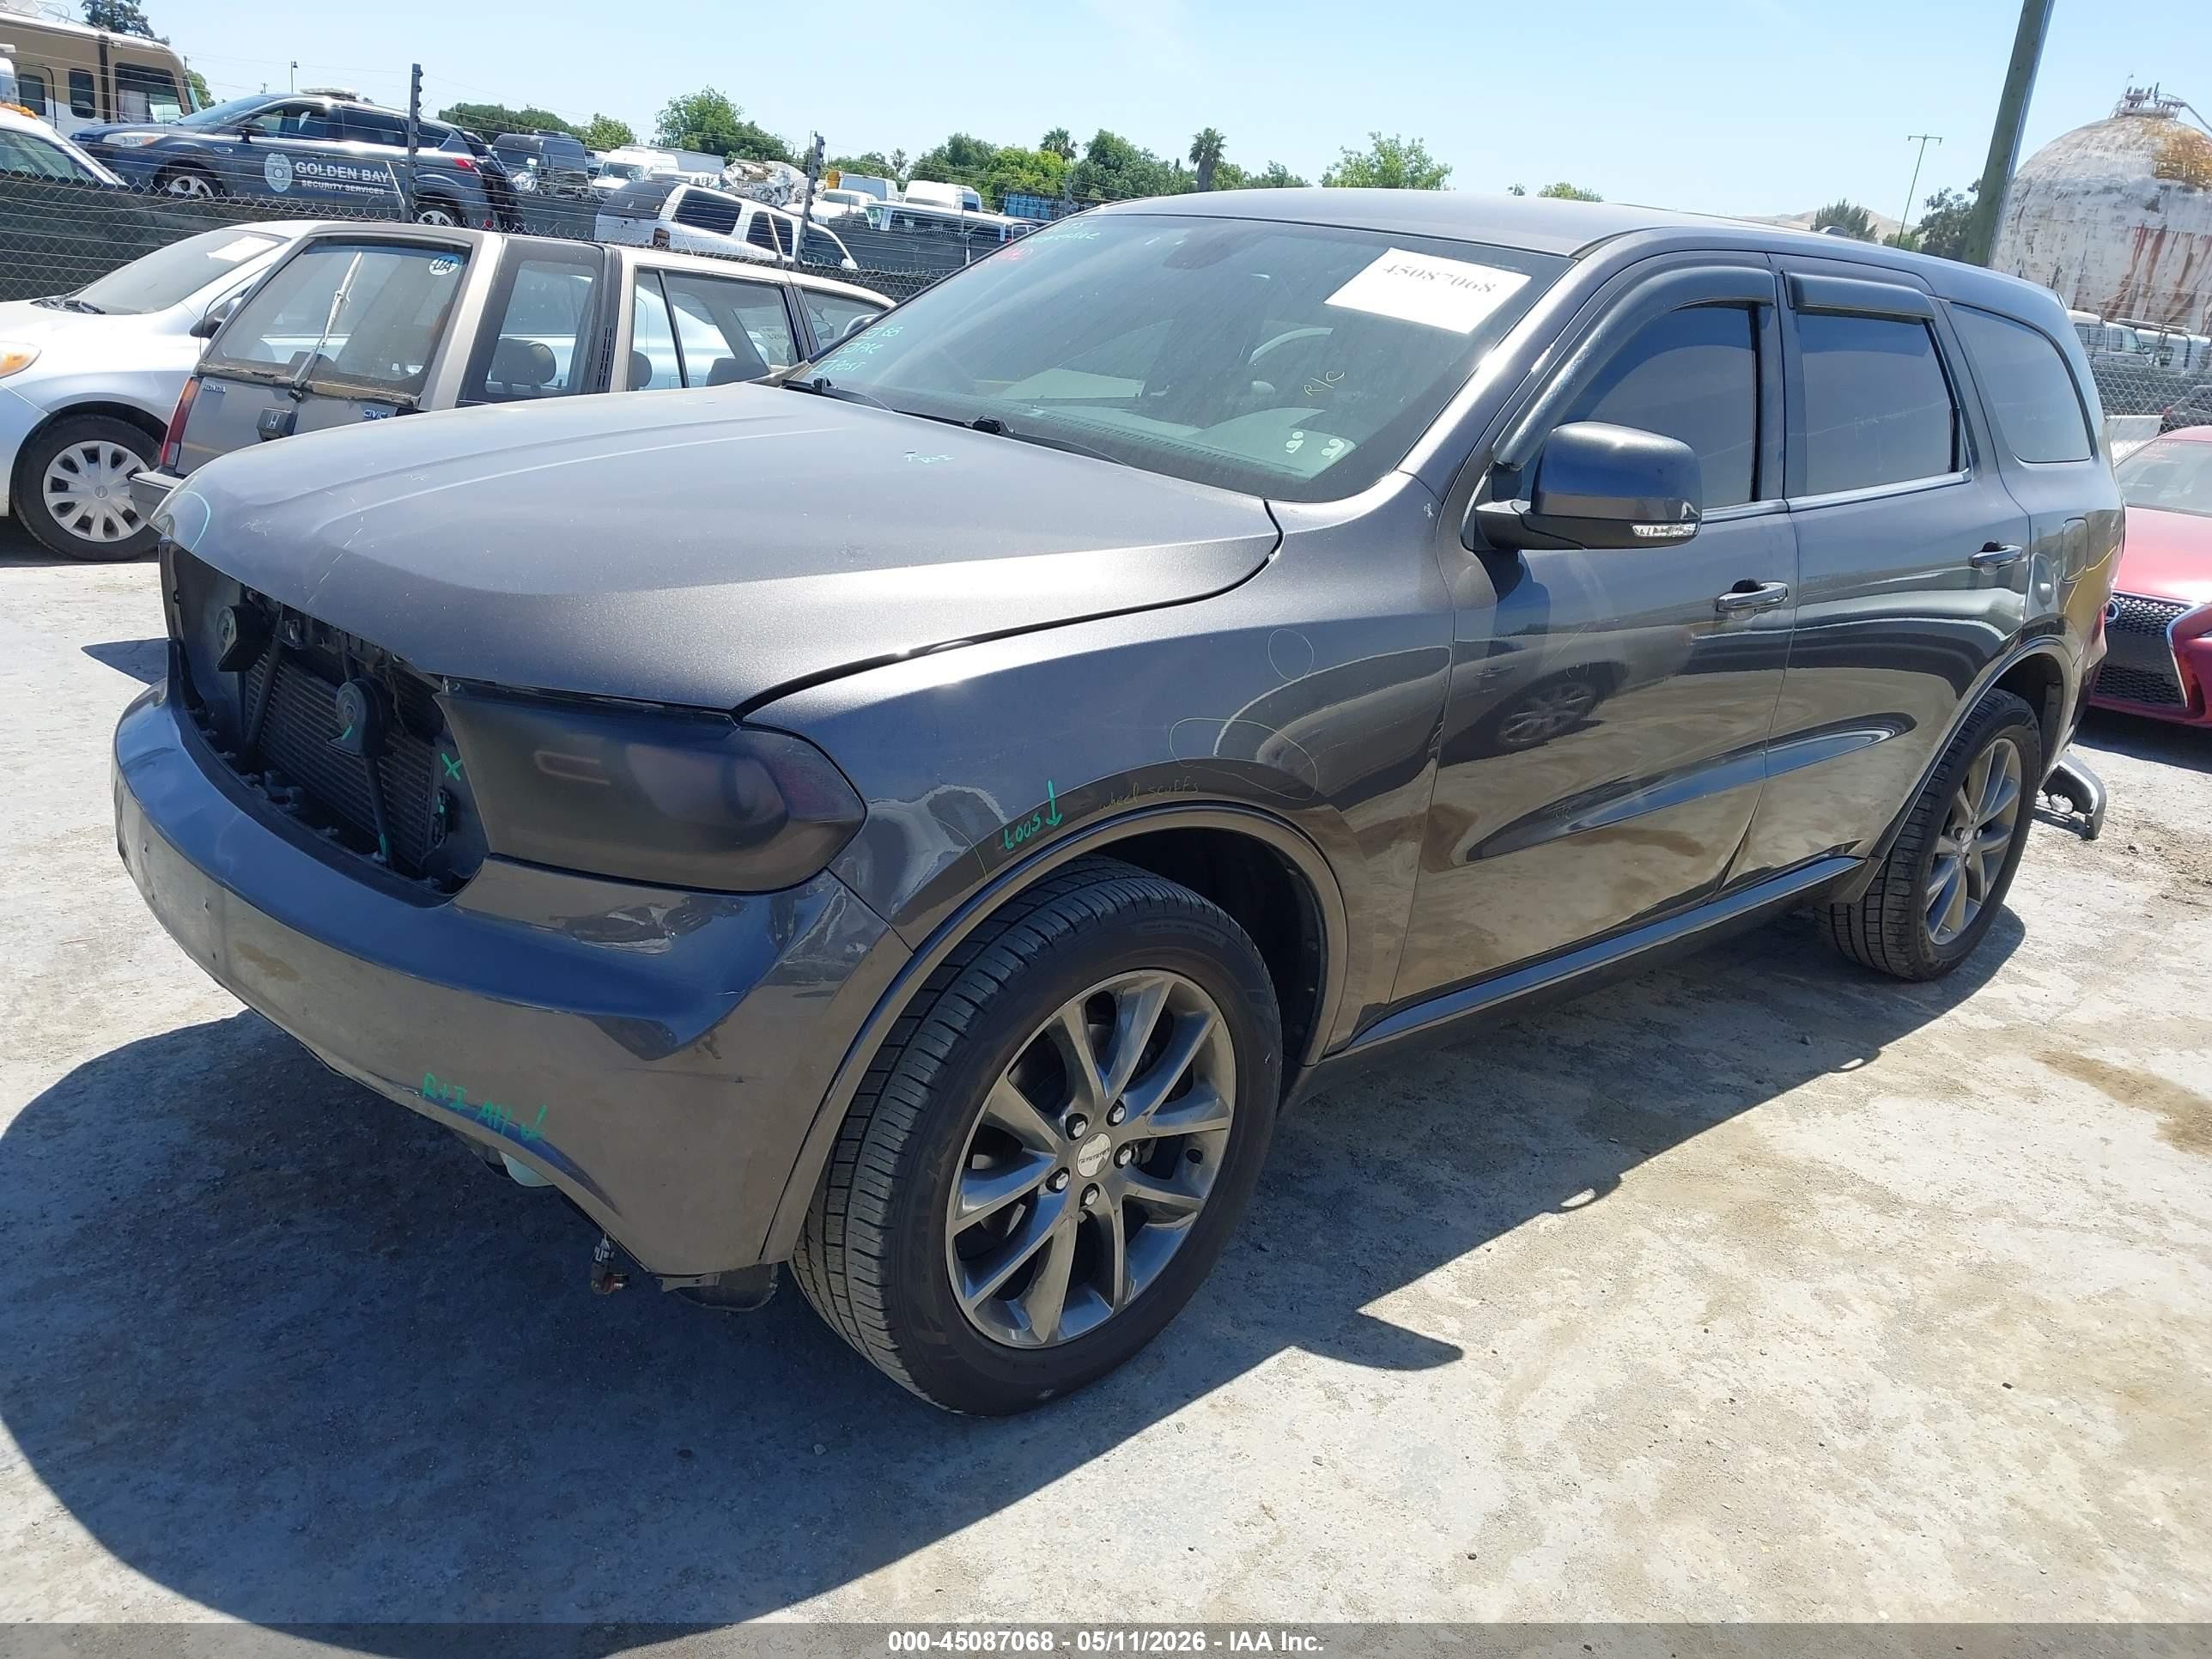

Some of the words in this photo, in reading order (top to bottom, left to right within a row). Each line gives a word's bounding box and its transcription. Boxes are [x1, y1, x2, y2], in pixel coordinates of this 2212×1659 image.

[295, 161, 357, 179] GOLDEN
[362, 169, 389, 183] BAY
[301, 179, 343, 191] SECURITY
[345, 184, 385, 195] SERVICES
[1382, 264, 1497, 293] 45087068
